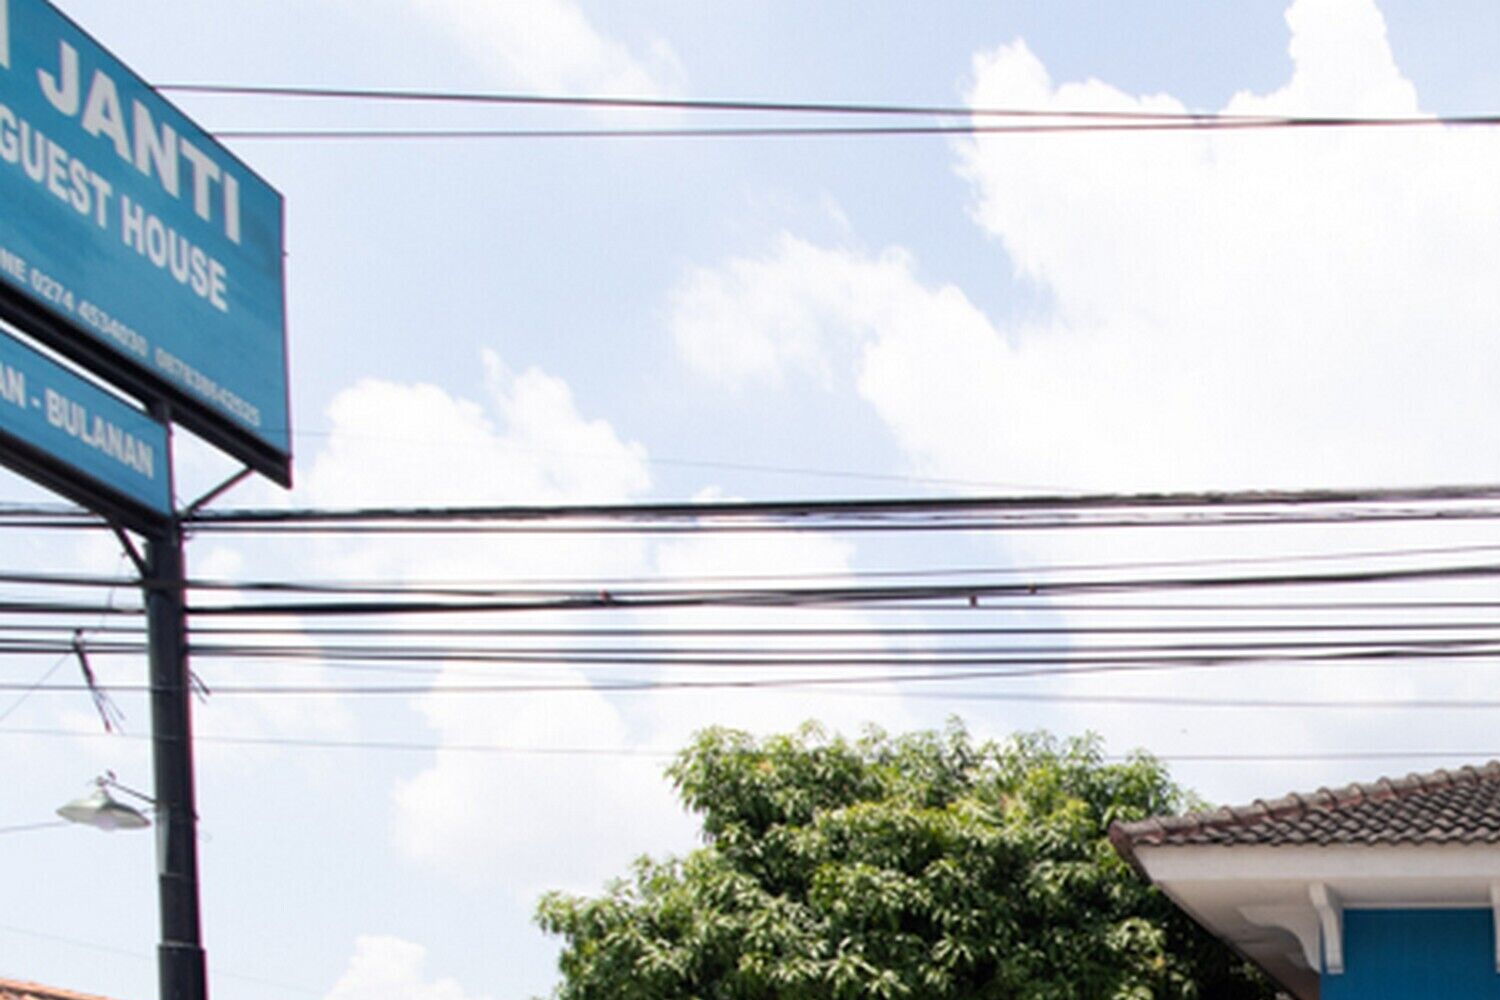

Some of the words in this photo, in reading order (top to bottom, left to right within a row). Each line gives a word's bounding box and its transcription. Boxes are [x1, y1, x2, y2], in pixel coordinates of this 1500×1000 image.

[0, 104, 113, 229] GUEST
[121, 192, 228, 313] HOUSE
[37, 40, 241, 246] JANTI
[31, 268, 74, 313] 0274
[45, 387, 155, 480] BULANAN
